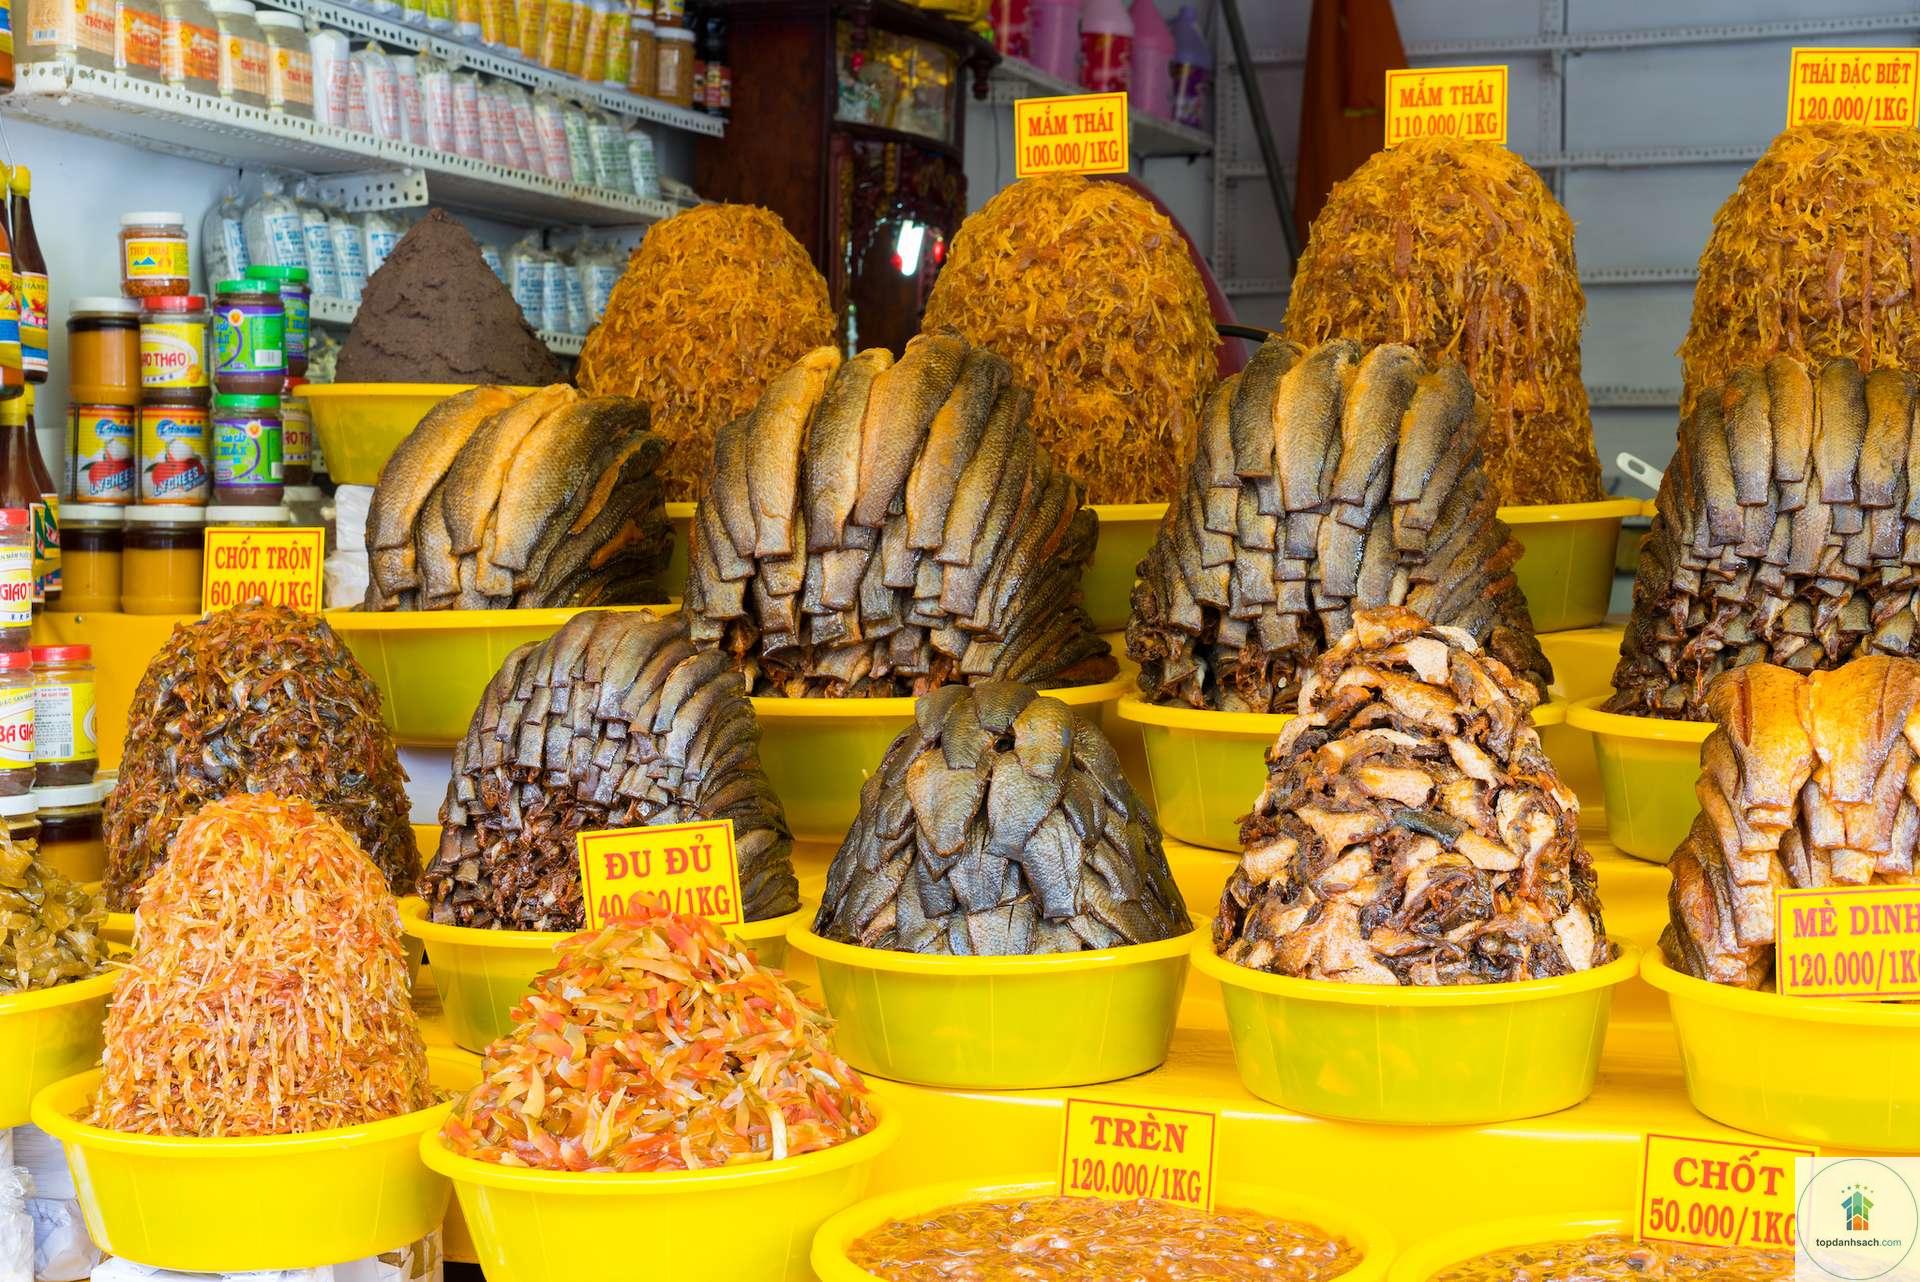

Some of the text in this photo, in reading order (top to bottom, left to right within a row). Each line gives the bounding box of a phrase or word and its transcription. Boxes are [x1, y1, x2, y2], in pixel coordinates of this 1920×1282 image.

[1800, 57, 1912, 89] THÁI ĐẶC BIỆT
[1400, 77, 1494, 108] MẮM THÁI
[1028, 105, 1114, 136] MẮM THÁI
[1394, 112, 1498, 138] 110.000/1KG
[1798, 96, 1908, 126] 120.000/1KG
[1025, 140, 1119, 168] 100.000/1KG
[215, 535, 313, 575] CHỐT TRỘN
[211, 580, 313, 608] 60.000/1KG
[603, 833, 712, 880] ĐU ĐỦ
[598, 885, 731, 920] 400/1KG
[1792, 898, 1920, 938] MÈ DINH
[1789, 949, 1920, 991] 120.000/1K
[1090, 1112, 1188, 1153] TRÈN
[1071, 1158, 1202, 1203] 120.000/1KG
[1673, 1150, 1785, 1196] CHỐT
